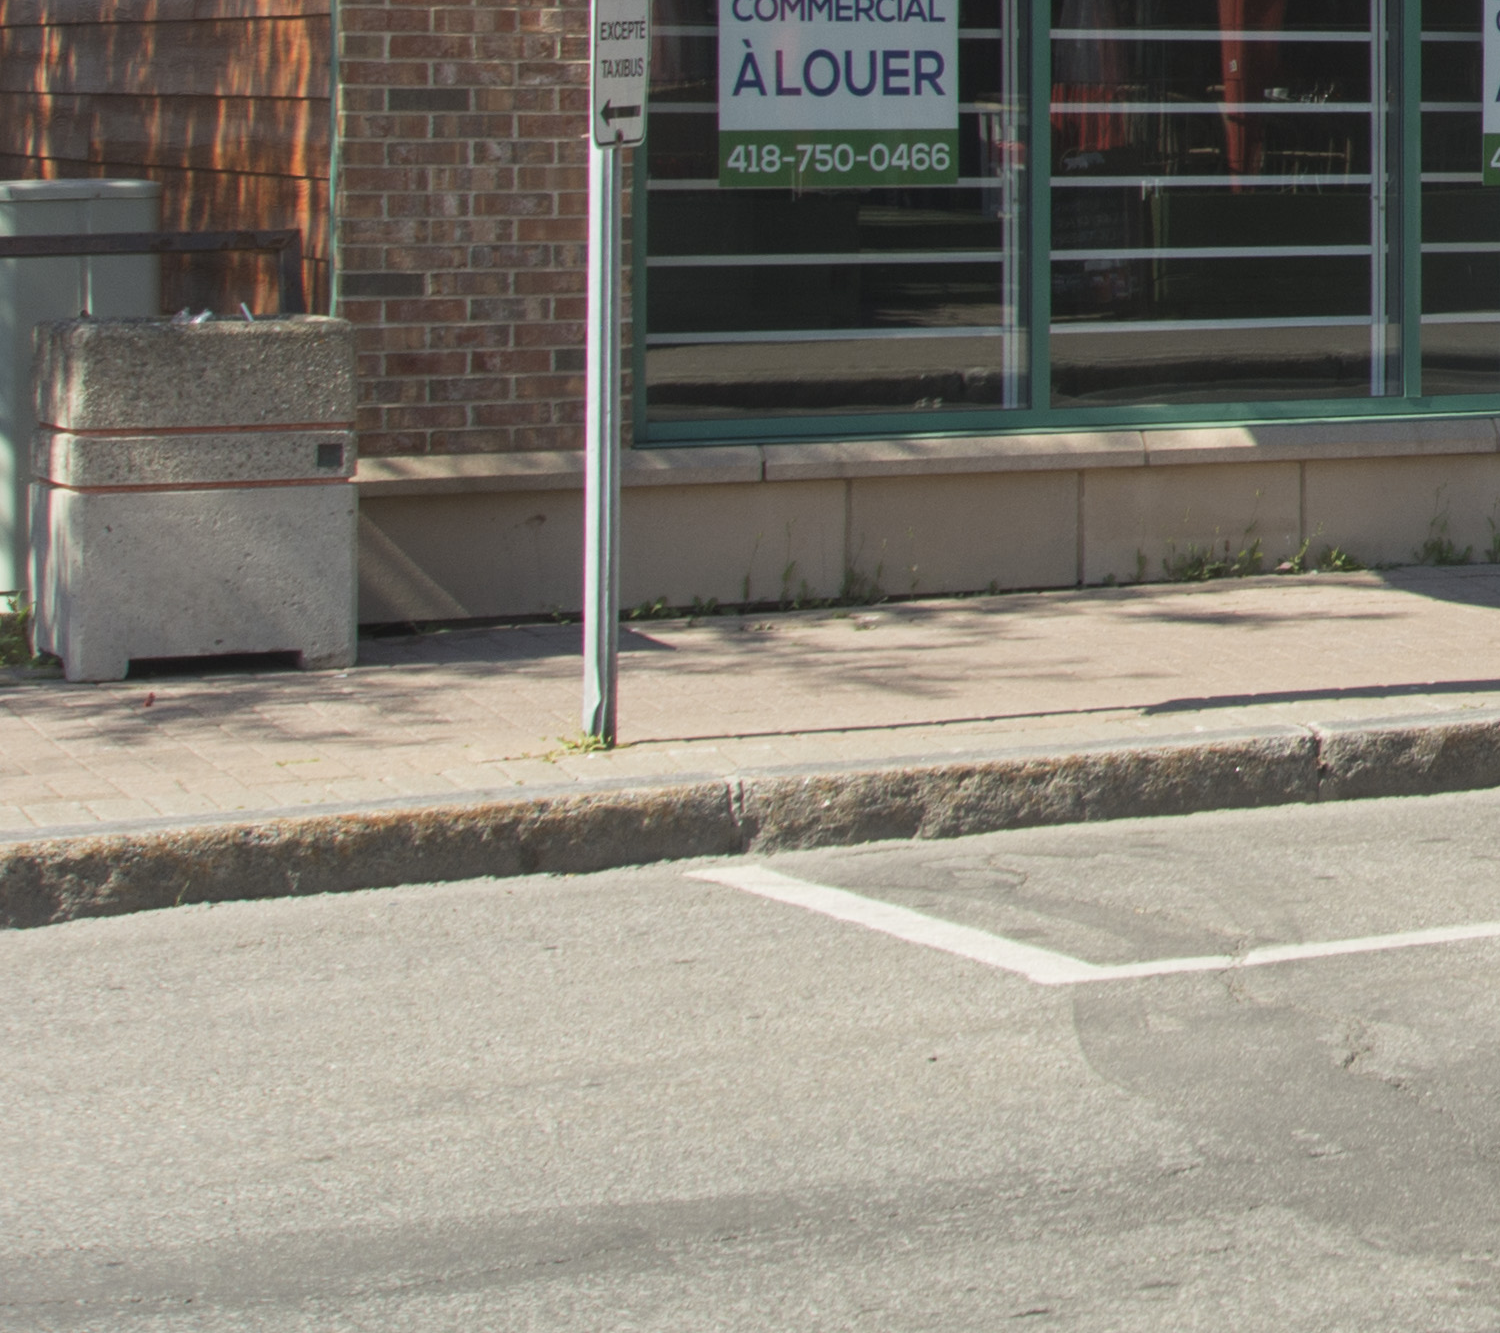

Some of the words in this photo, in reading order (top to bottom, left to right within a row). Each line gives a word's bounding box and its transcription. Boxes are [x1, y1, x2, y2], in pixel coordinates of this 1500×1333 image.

[600, 15, 646, 41] EXCEPTÉ
[601, 57, 644, 79] TAXIBUS
[732, 38, 768, 97] À
[774, 48, 946, 98] LOUER
[727, 142, 951, 174] 418-750-0466
